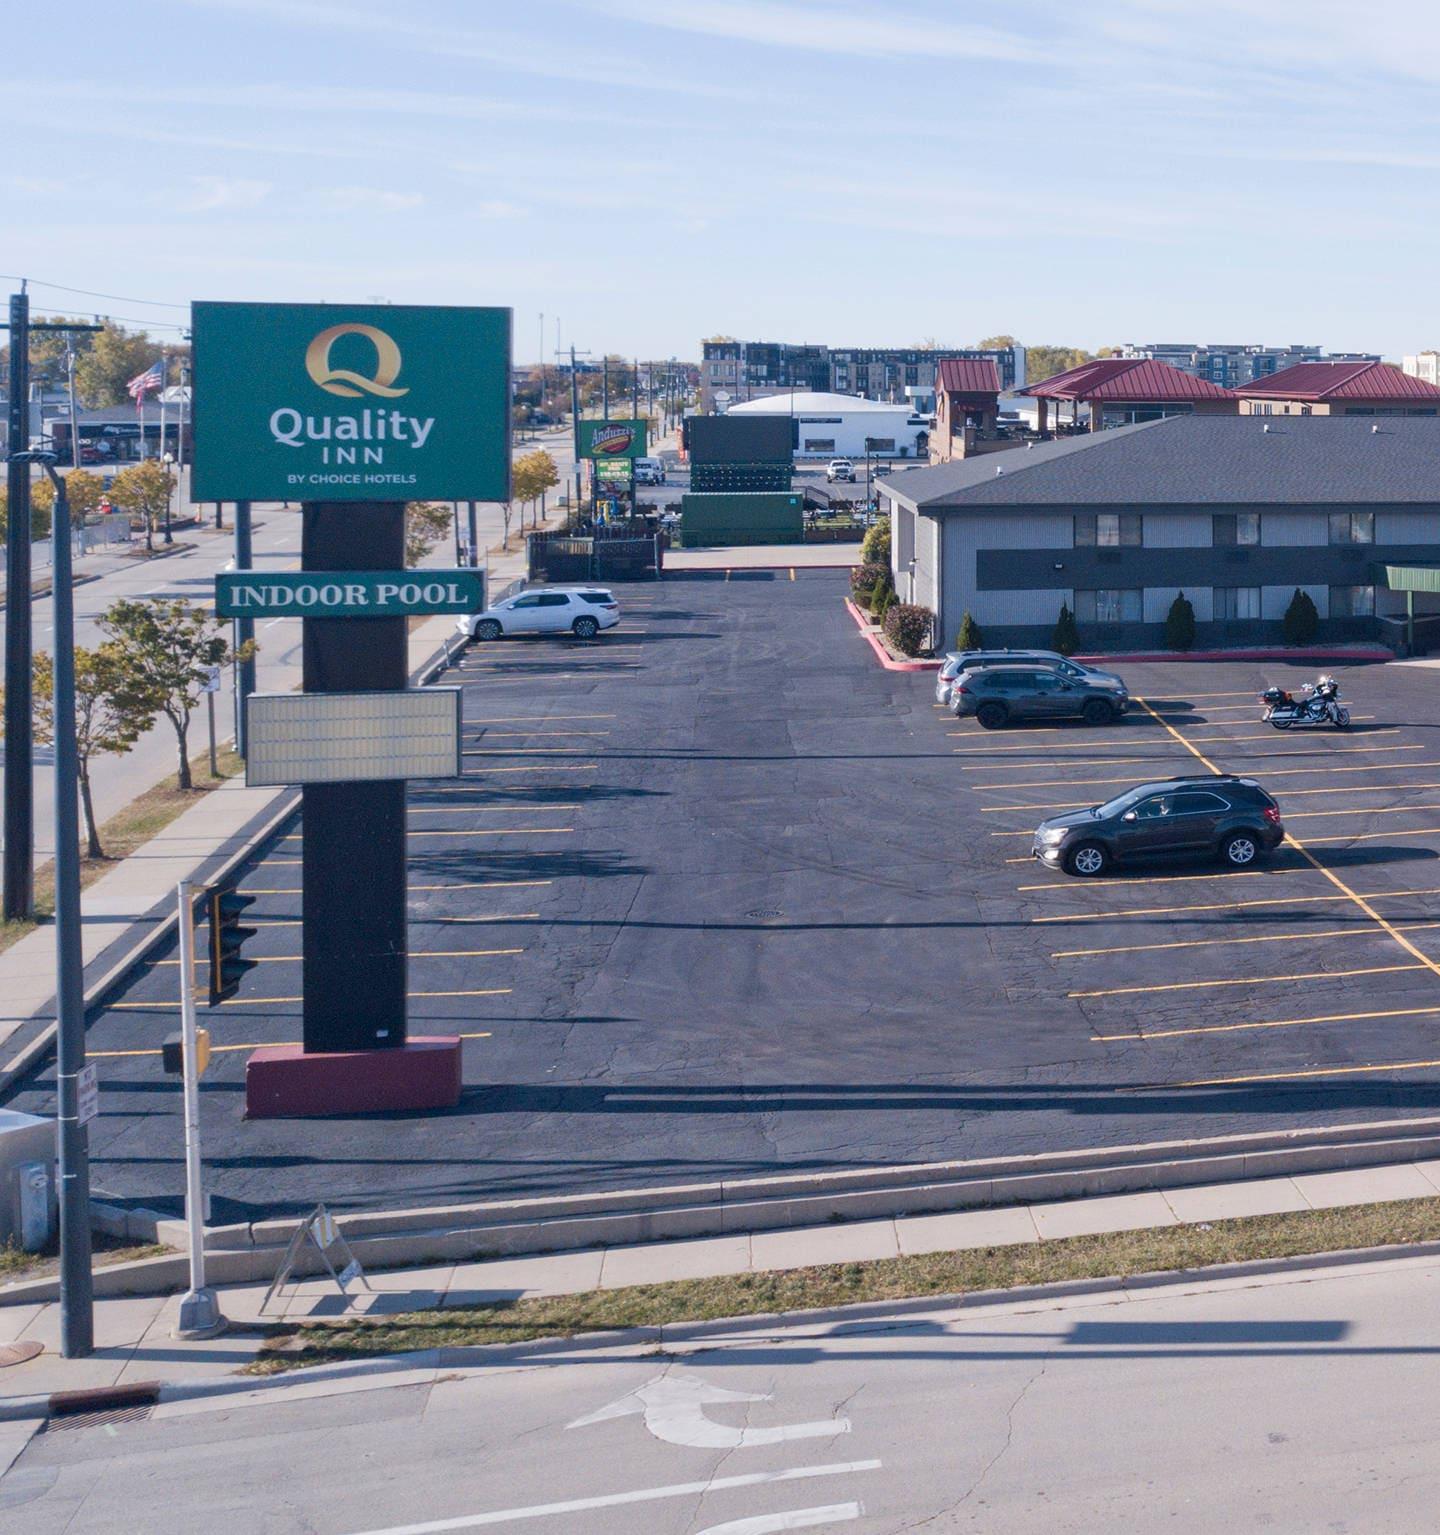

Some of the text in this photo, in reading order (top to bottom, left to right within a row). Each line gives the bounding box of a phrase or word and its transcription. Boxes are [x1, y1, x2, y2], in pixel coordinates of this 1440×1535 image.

[305, 323, 410, 397] Q
[269, 407, 435, 448] Quality
[322, 447, 384, 465] INN
[287, 474, 417, 484] BY CHOICE HOTELS
[230, 583, 468, 607] INDOOR POOL
